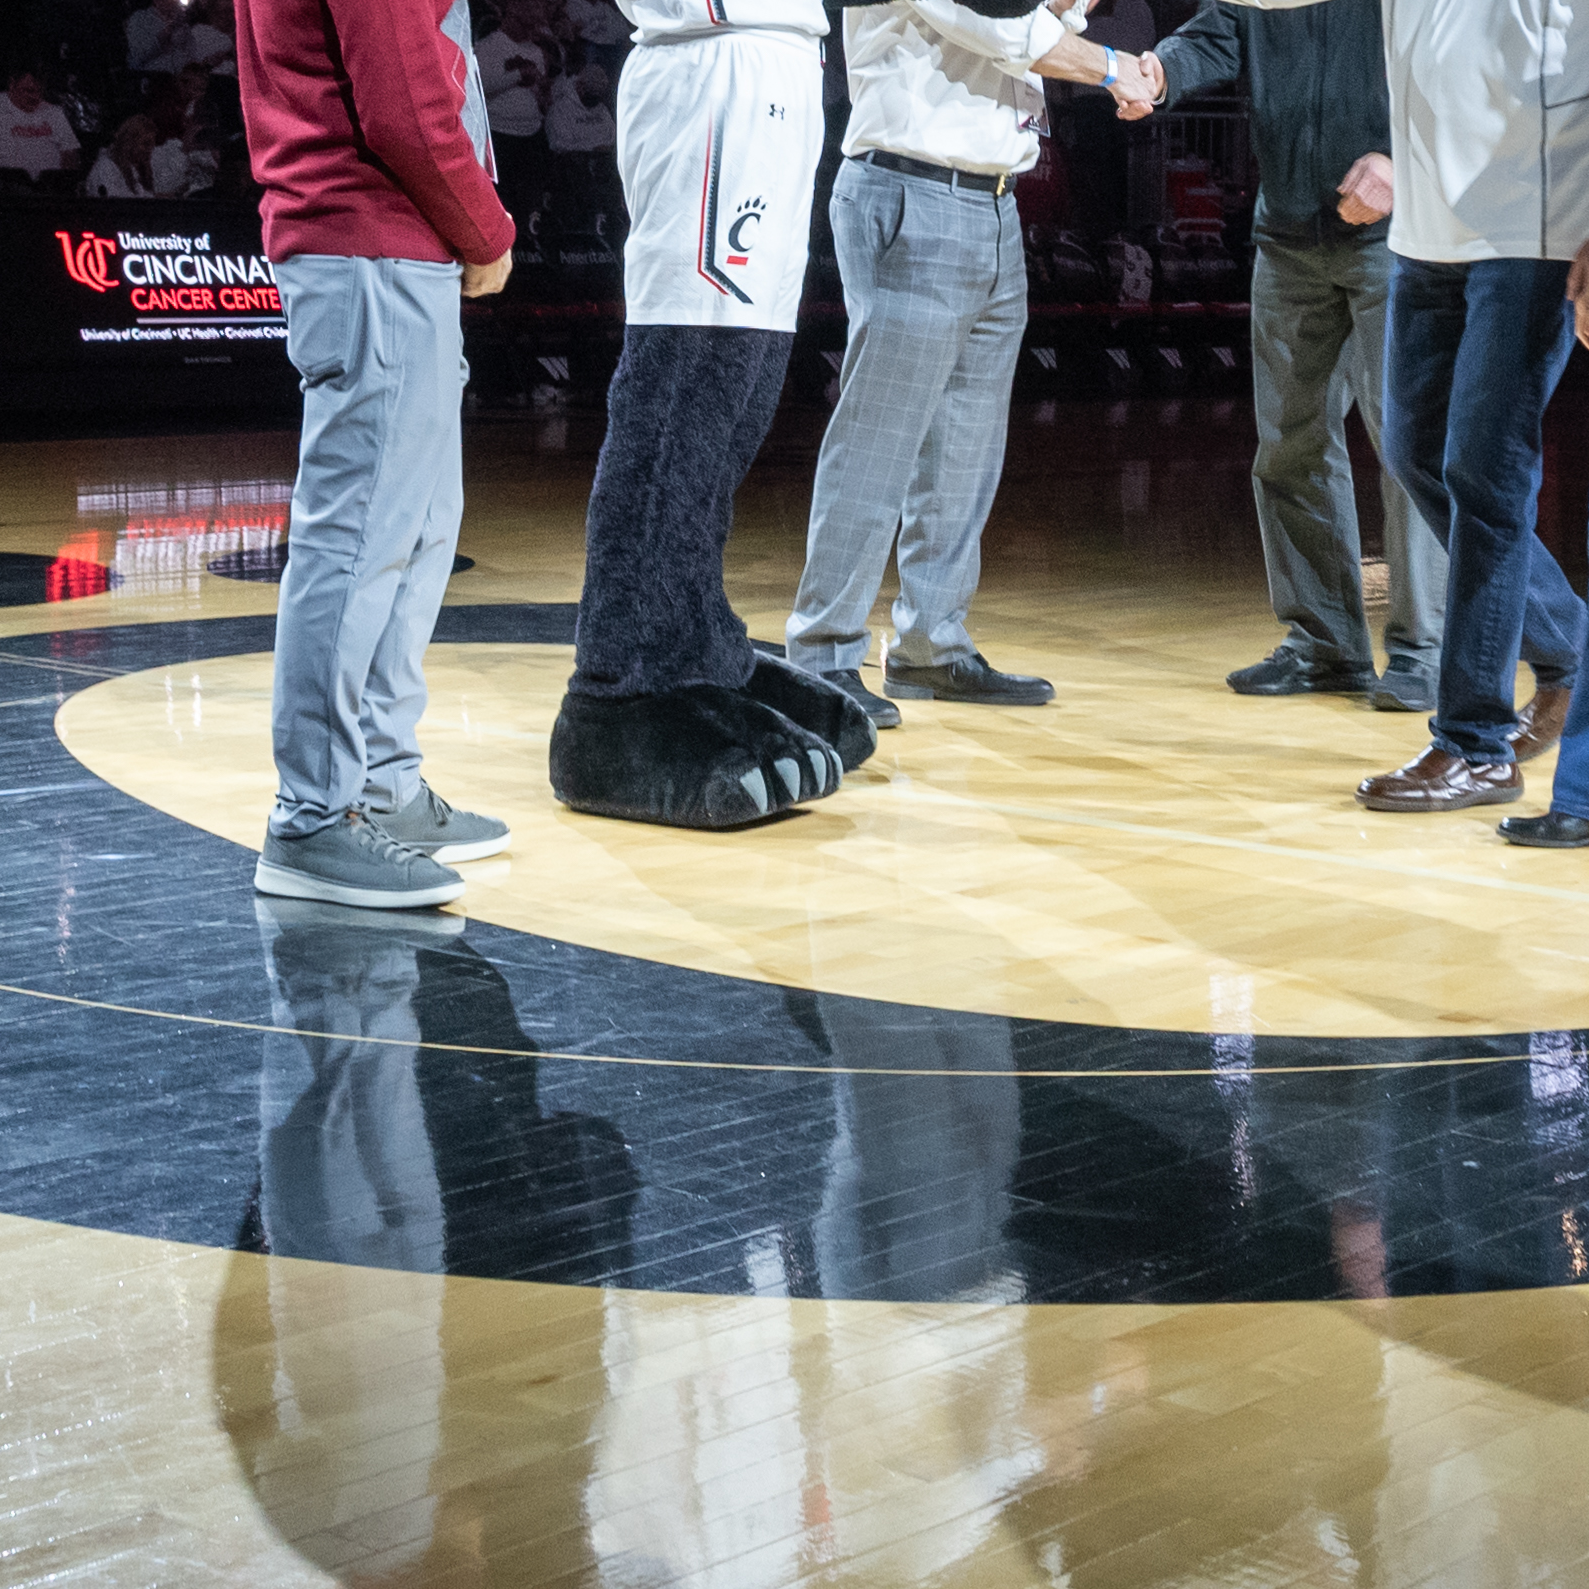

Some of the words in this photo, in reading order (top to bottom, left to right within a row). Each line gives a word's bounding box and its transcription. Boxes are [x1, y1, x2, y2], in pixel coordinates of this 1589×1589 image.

[117, 231, 192, 255] University
[194, 232, 211, 252] of
[123, 254, 278, 286] CINCINNAT
[130, 288, 217, 311] CANCER
[219, 288, 282, 311] CENTE
